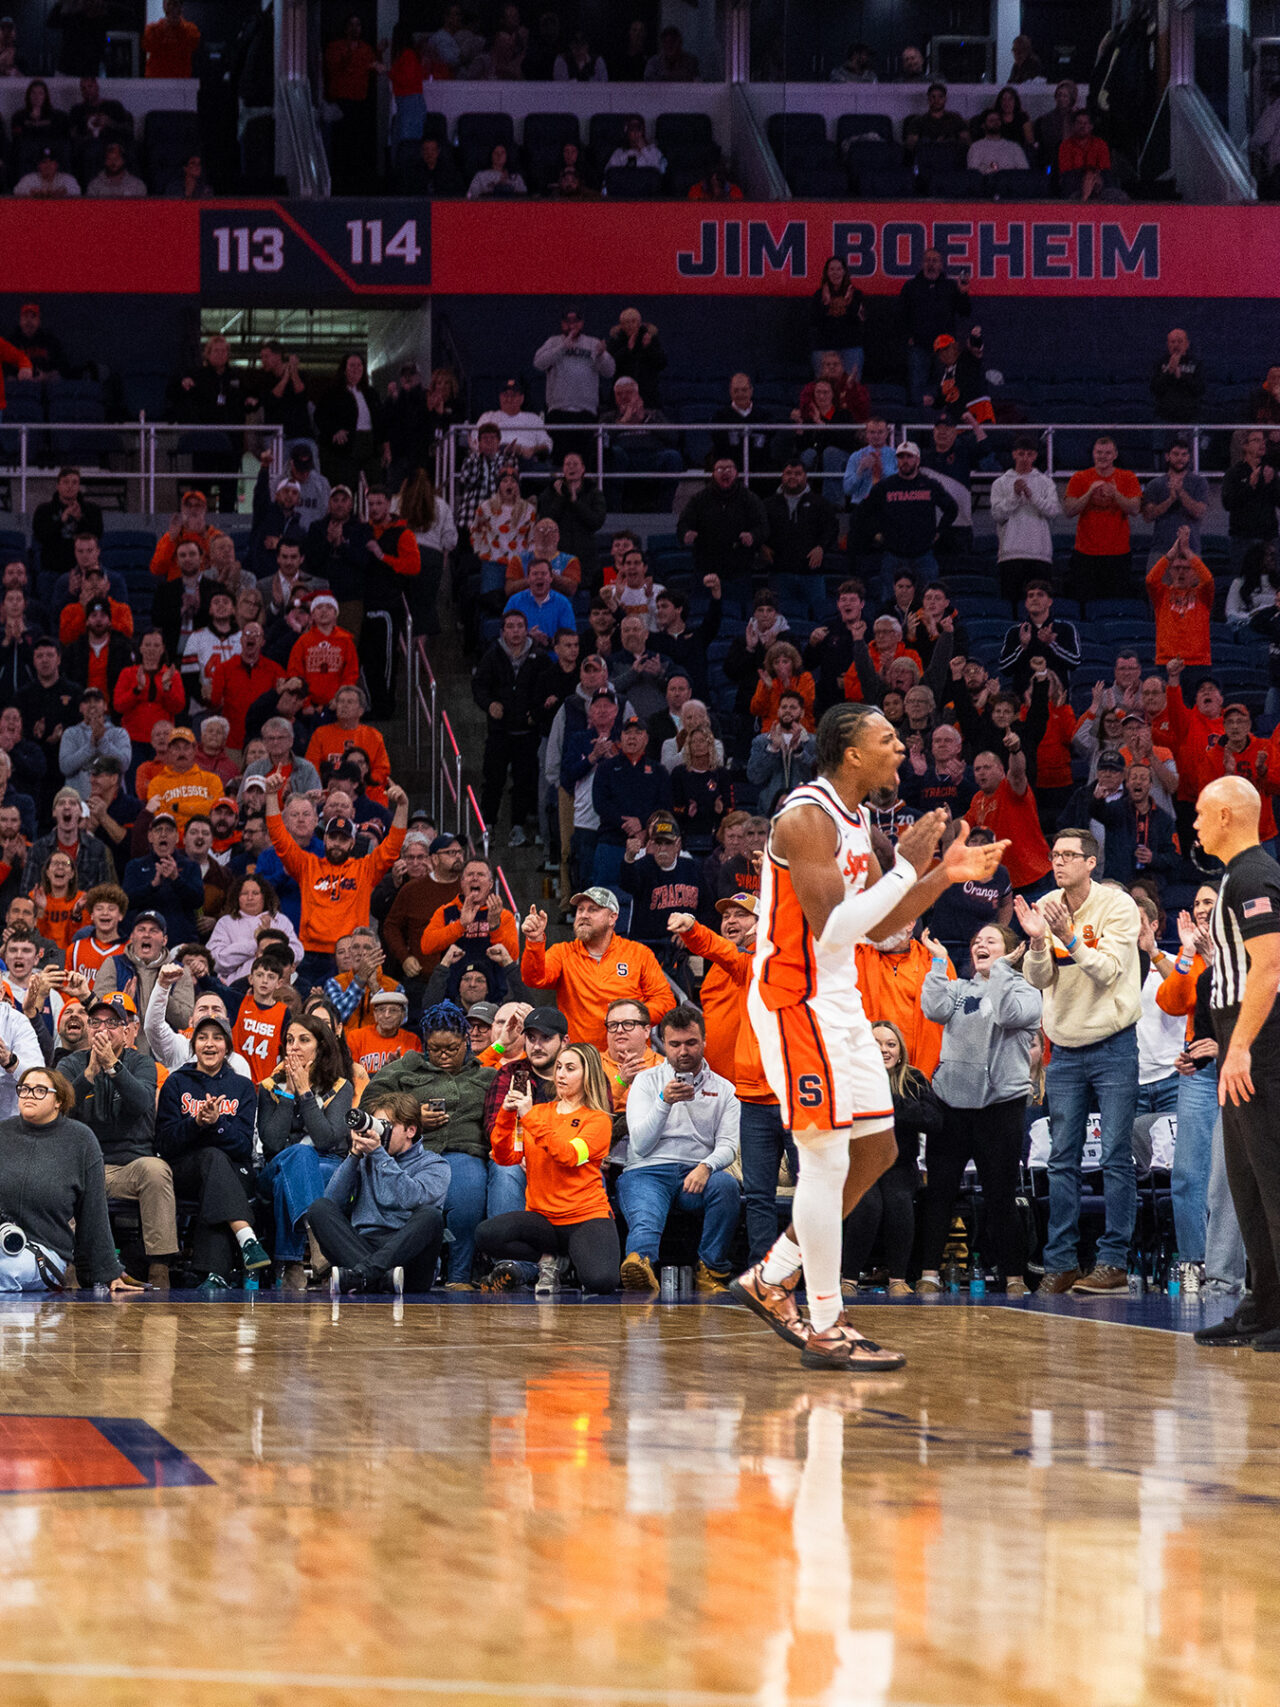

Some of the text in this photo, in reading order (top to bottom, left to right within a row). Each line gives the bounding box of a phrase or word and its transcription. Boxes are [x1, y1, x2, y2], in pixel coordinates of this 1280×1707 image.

[213, 227, 285, 273] 113
[346, 219, 422, 264] 114
[677, 220, 1161, 280] JIM BOEHEIM
[963, 880, 998, 901] Orange
[1081, 924, 1095, 940] S
[615, 962, 629, 977] S
[242, 1035, 269, 1060] 44
[798, 1073, 824, 1107] S
[181, 1092, 239, 1117] Syruse
